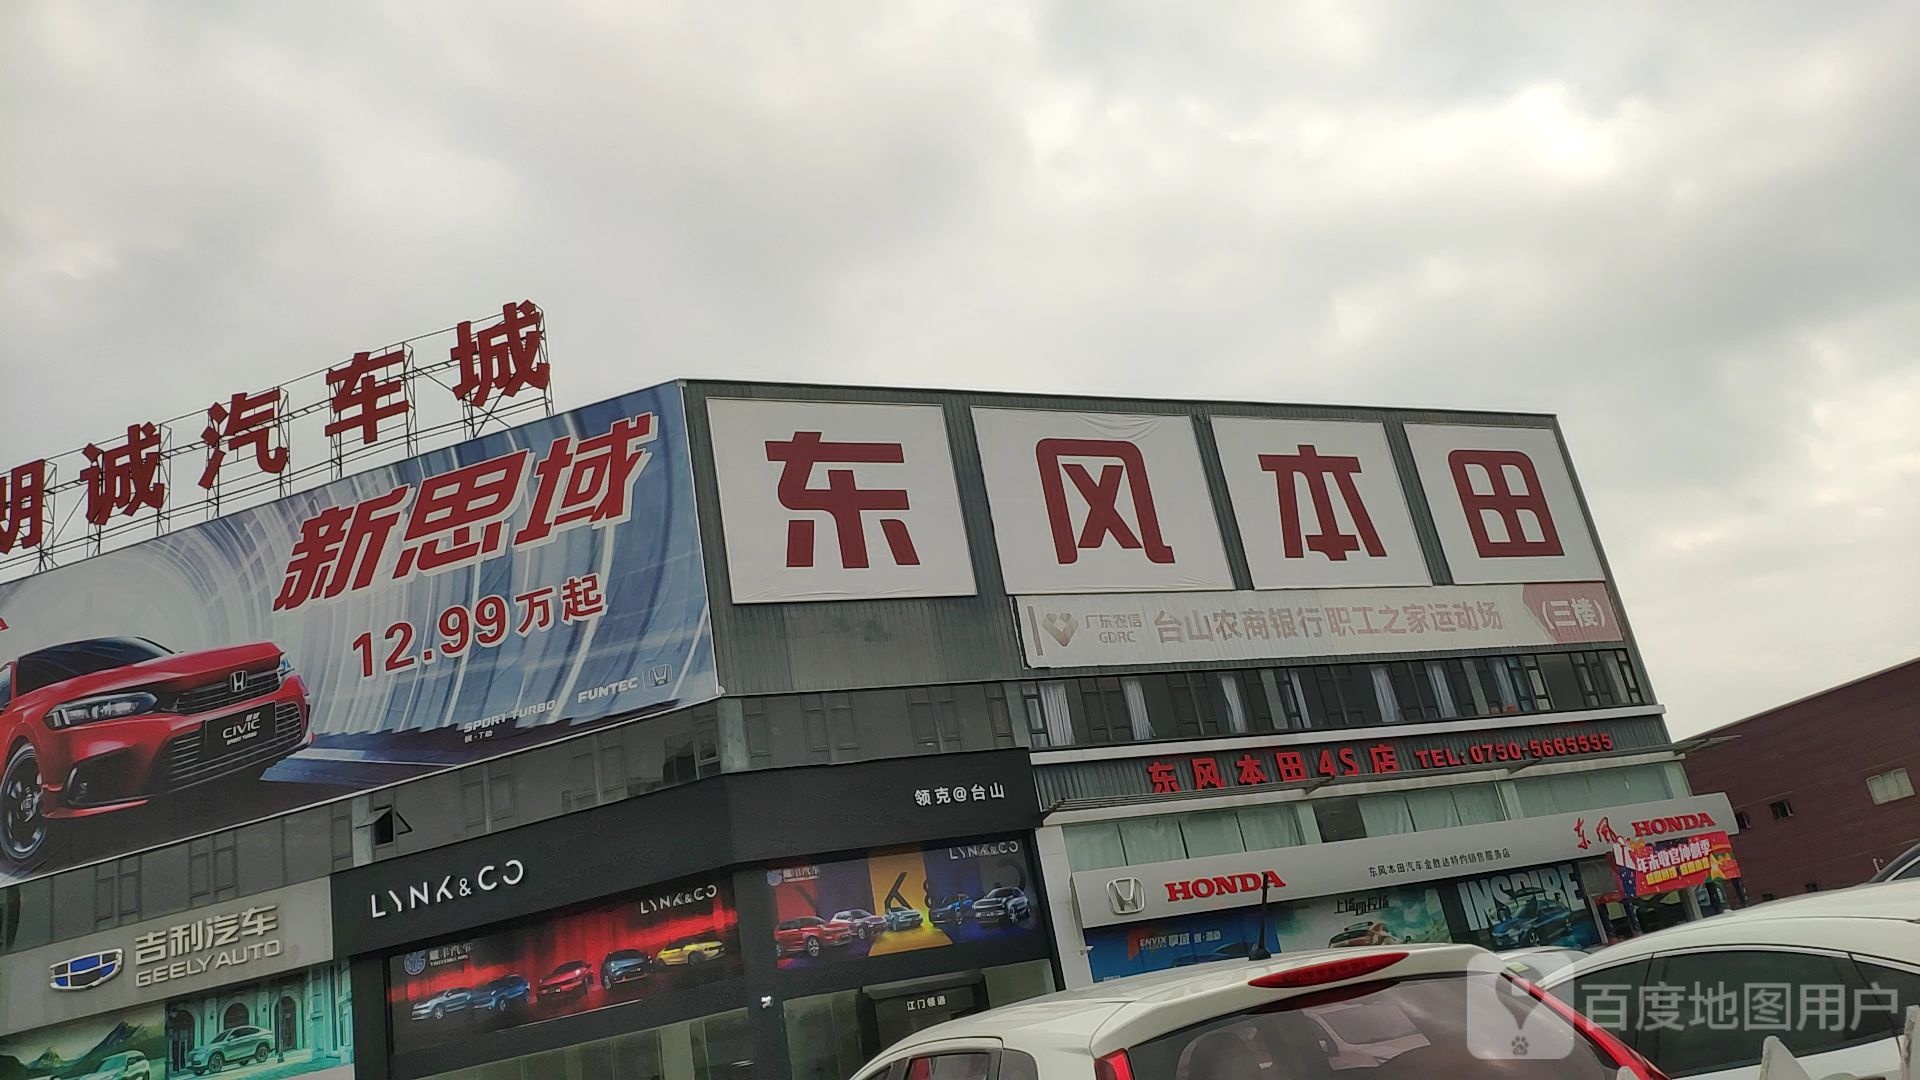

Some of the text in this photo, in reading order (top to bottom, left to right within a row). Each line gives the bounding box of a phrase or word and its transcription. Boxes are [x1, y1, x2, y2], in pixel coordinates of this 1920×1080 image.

[273, 412, 656, 612] 新思域
[765, 431, 1566, 569] 东风本田
[1085, 613, 1143, 629] 广东农信
[1099, 631, 1137, 643] GDRC
[1154, 600, 1504, 644] 台山农商银行职工之家运动场
[577, 677, 638, 703] FUNTEC
[222, 718, 261, 739] CIVIC
[463, 699, 556, 733] SPORT TURBO
[1148, 744, 1400, 794] 东风本田4S店
[1470, 733, 1614, 764] 0750-5665555
[915, 782, 1005, 806] 领克@台山
[1631, 811, 1717, 838] HONDA
[1164, 870, 1287, 902] HONDA
[135, 904, 277, 965] 吉利汽车
[1140, 936, 1167, 947] ENVIX
[135, 939, 280, 987] GEELY AUTO
